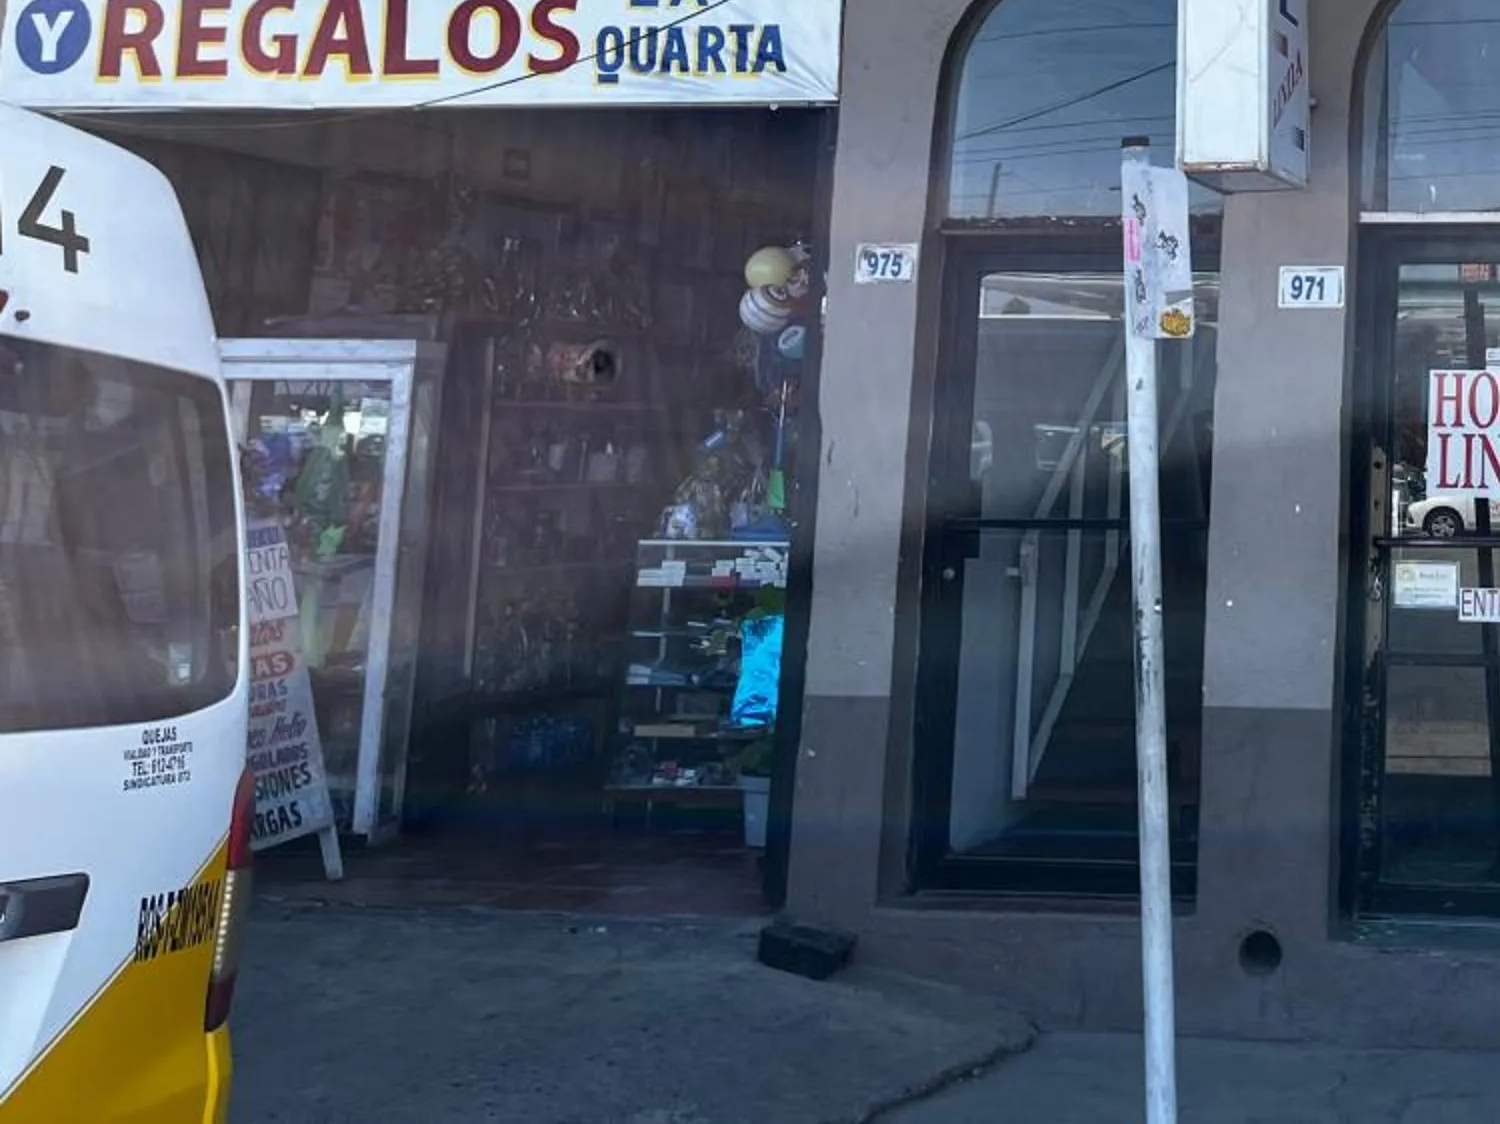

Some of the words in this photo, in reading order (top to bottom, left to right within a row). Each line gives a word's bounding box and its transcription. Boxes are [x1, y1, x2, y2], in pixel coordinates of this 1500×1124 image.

[596, 23, 788, 85] QUARTA
[0, 164, 91, 275] 4
[866, 251, 903, 277] 975
[1290, 276, 1326, 302] 971
[142, 727, 177, 745] QUEJAS
